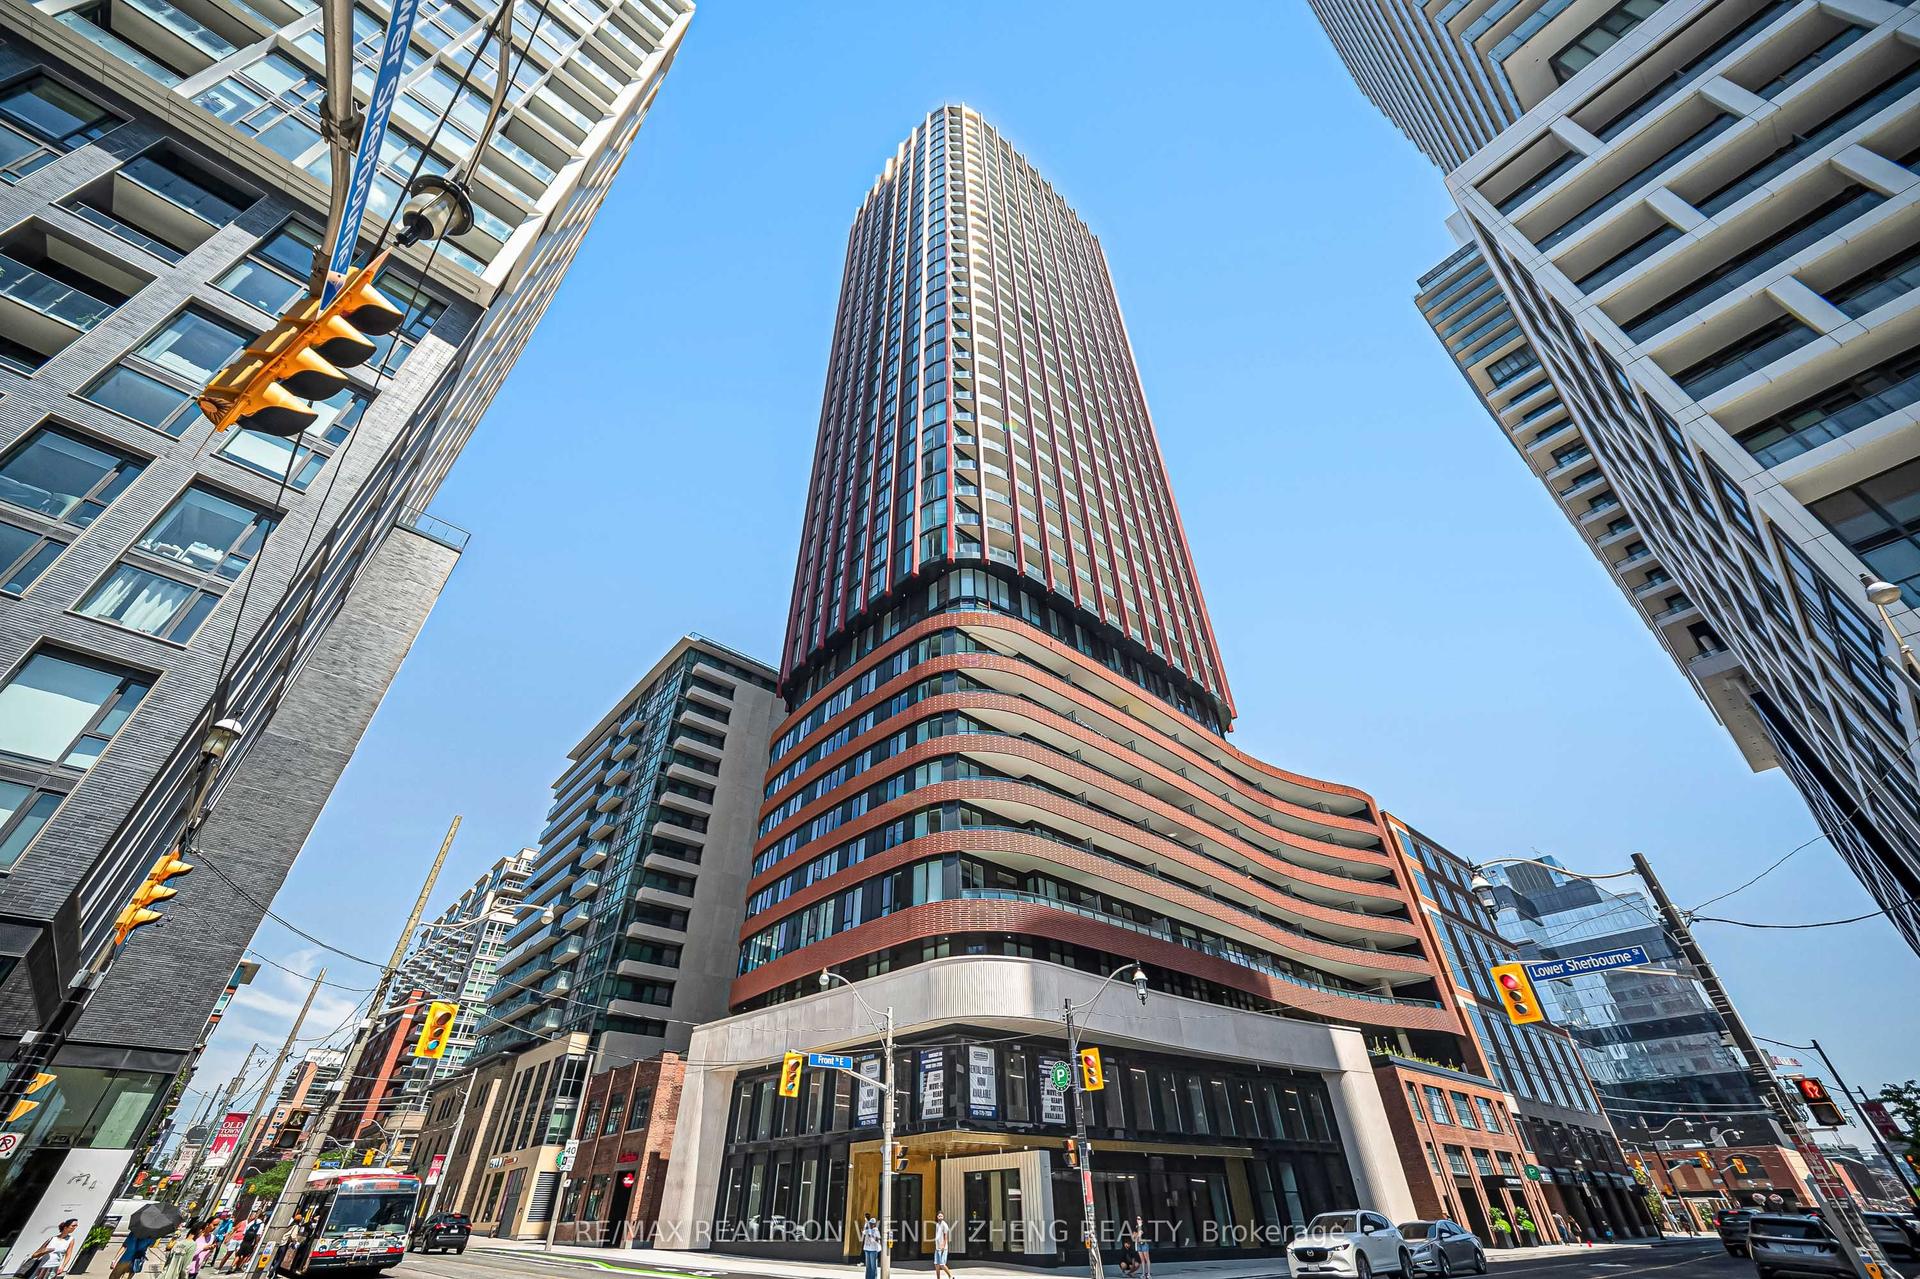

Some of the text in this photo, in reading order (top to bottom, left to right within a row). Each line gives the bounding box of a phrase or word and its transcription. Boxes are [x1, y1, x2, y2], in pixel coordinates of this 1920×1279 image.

[335, 0, 414, 271] wer Sherbourne
[1531, 963, 1565, 978] Lower
[1565, 951, 1632, 972] Sherbourne
[818, 1055, 834, 1065] Front
[1056, 1069, 1065, 1081] P
[222, 1121, 244, 1129] OLD
[566, 1146, 576, 1154] 40
[1529, 1168, 1536, 1176] P
